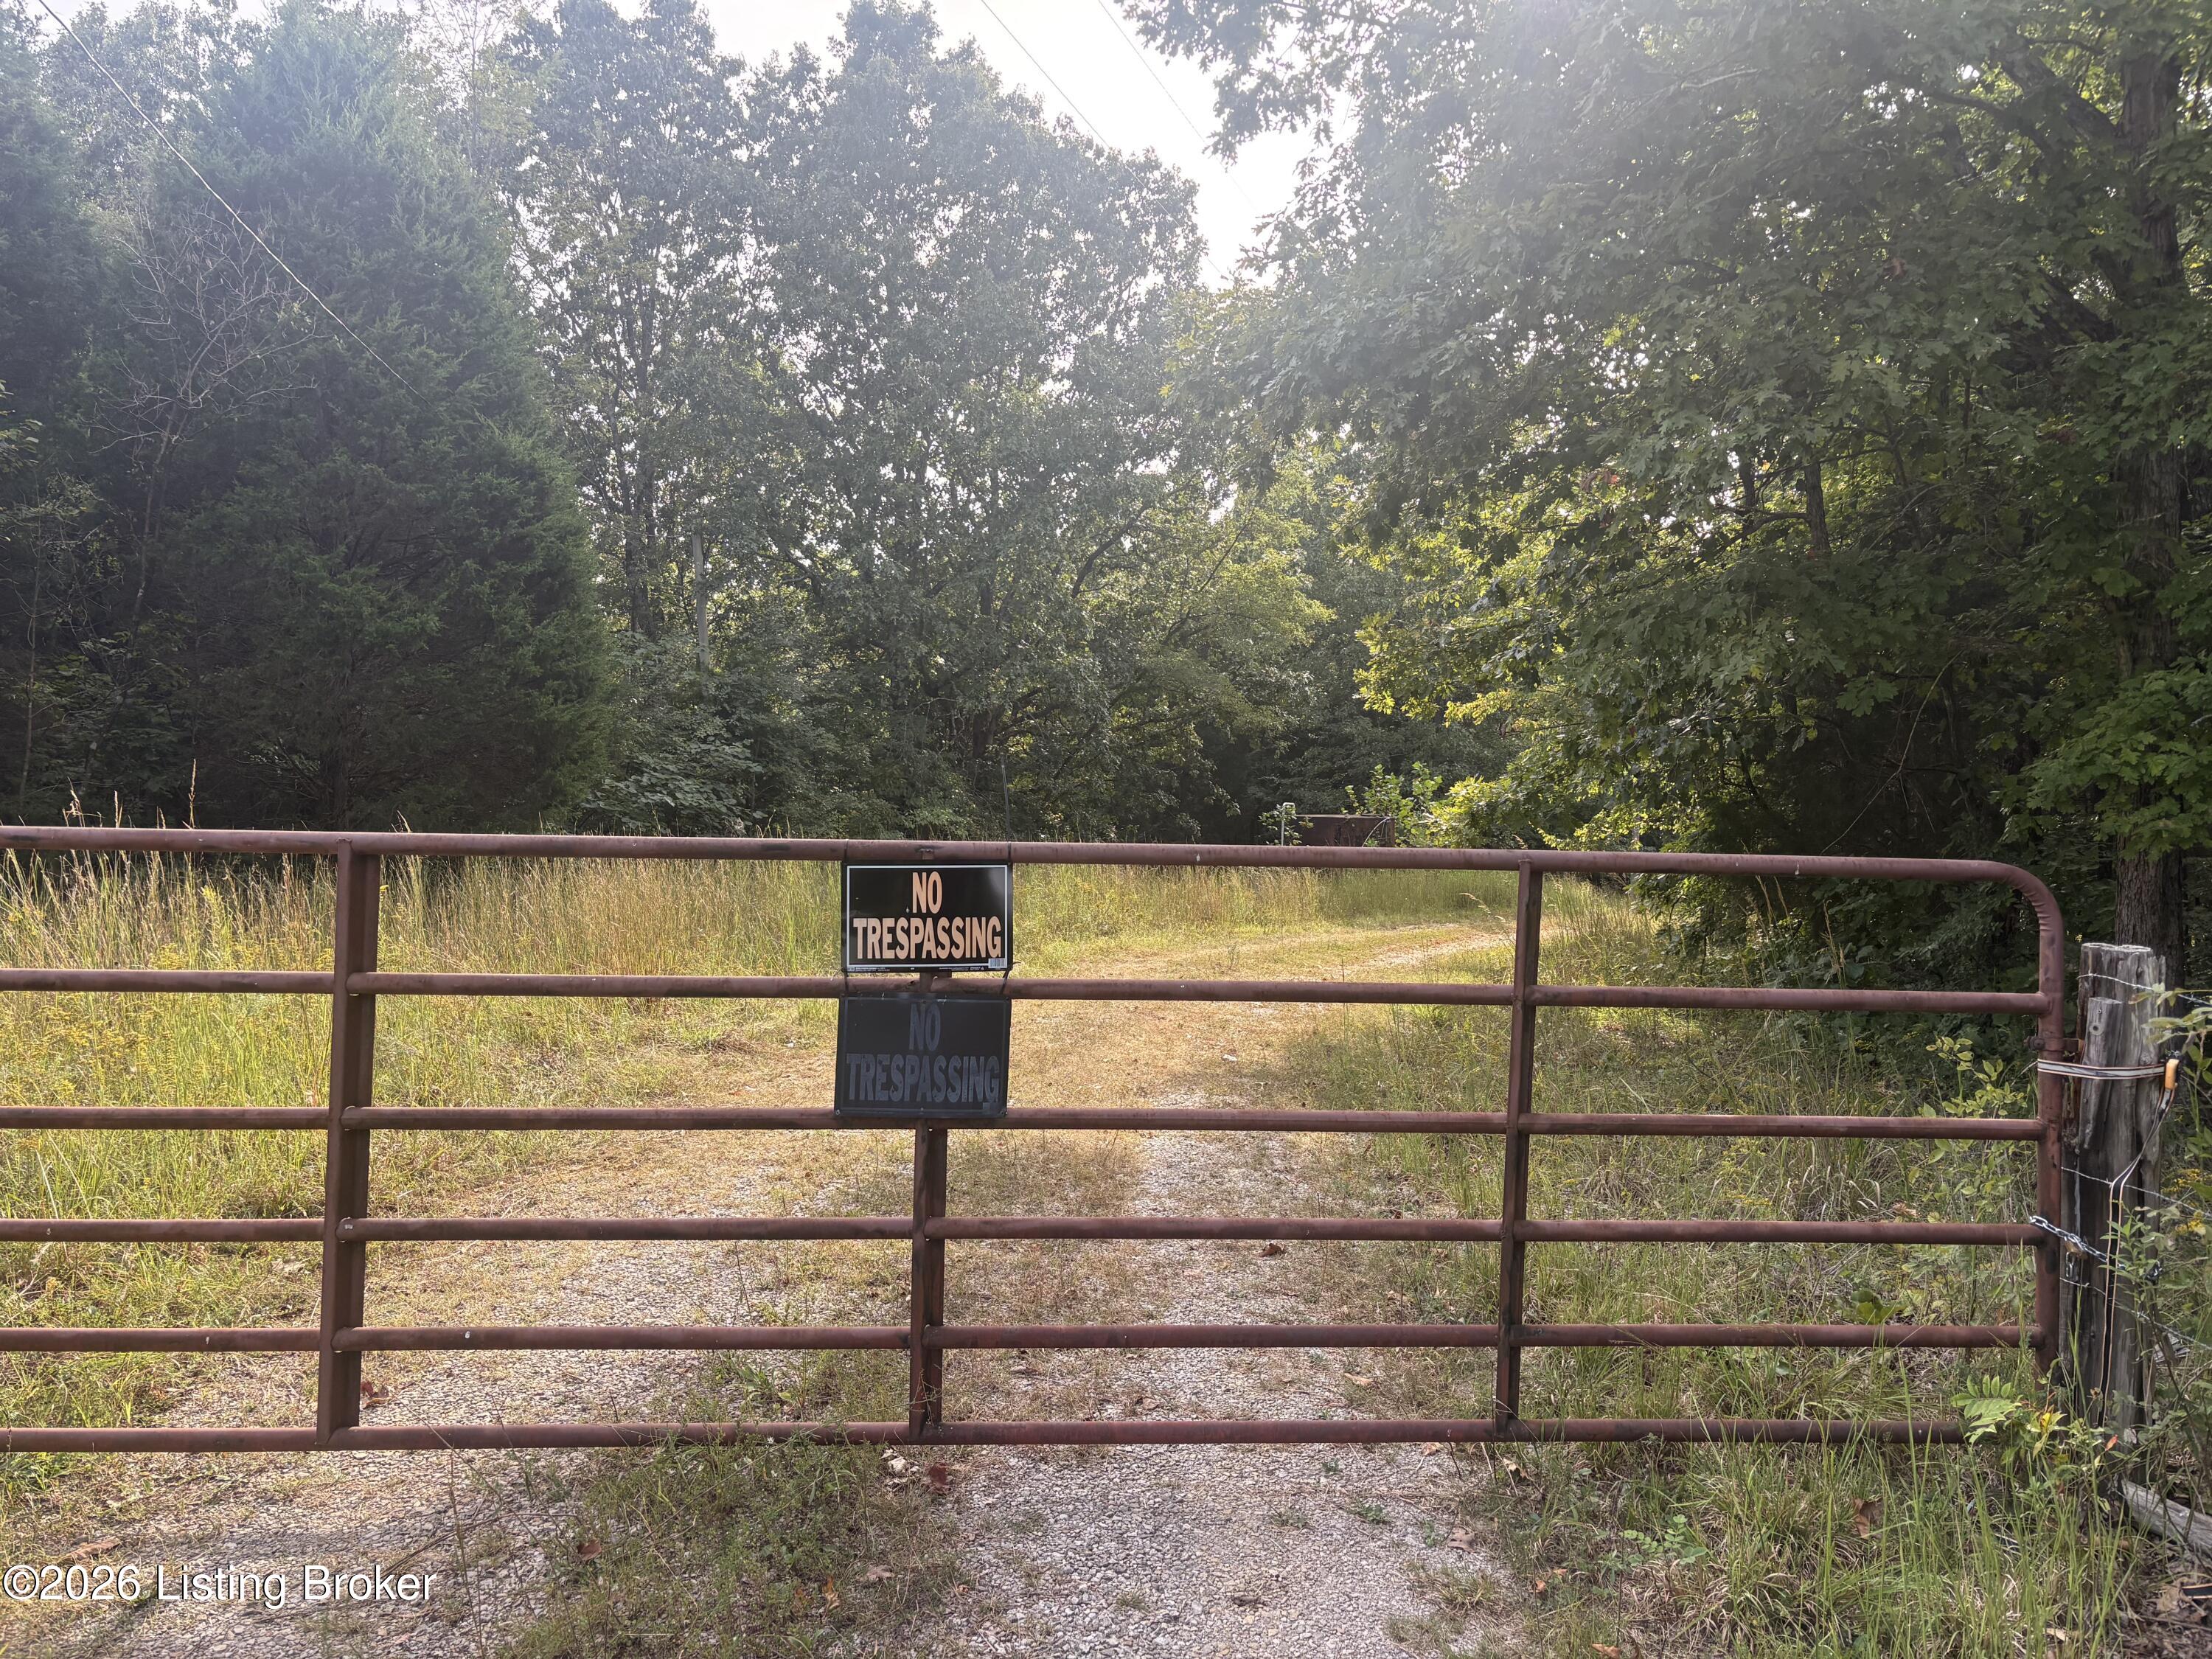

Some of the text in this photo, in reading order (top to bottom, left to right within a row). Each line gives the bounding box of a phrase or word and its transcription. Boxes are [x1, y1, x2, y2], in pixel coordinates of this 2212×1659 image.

[912, 871, 942, 914] NO
[853, 916, 1001, 959] TRESPASSING
[909, 1004, 941, 1051] NO
[846, 1054, 1000, 1103] TRESPASSING
